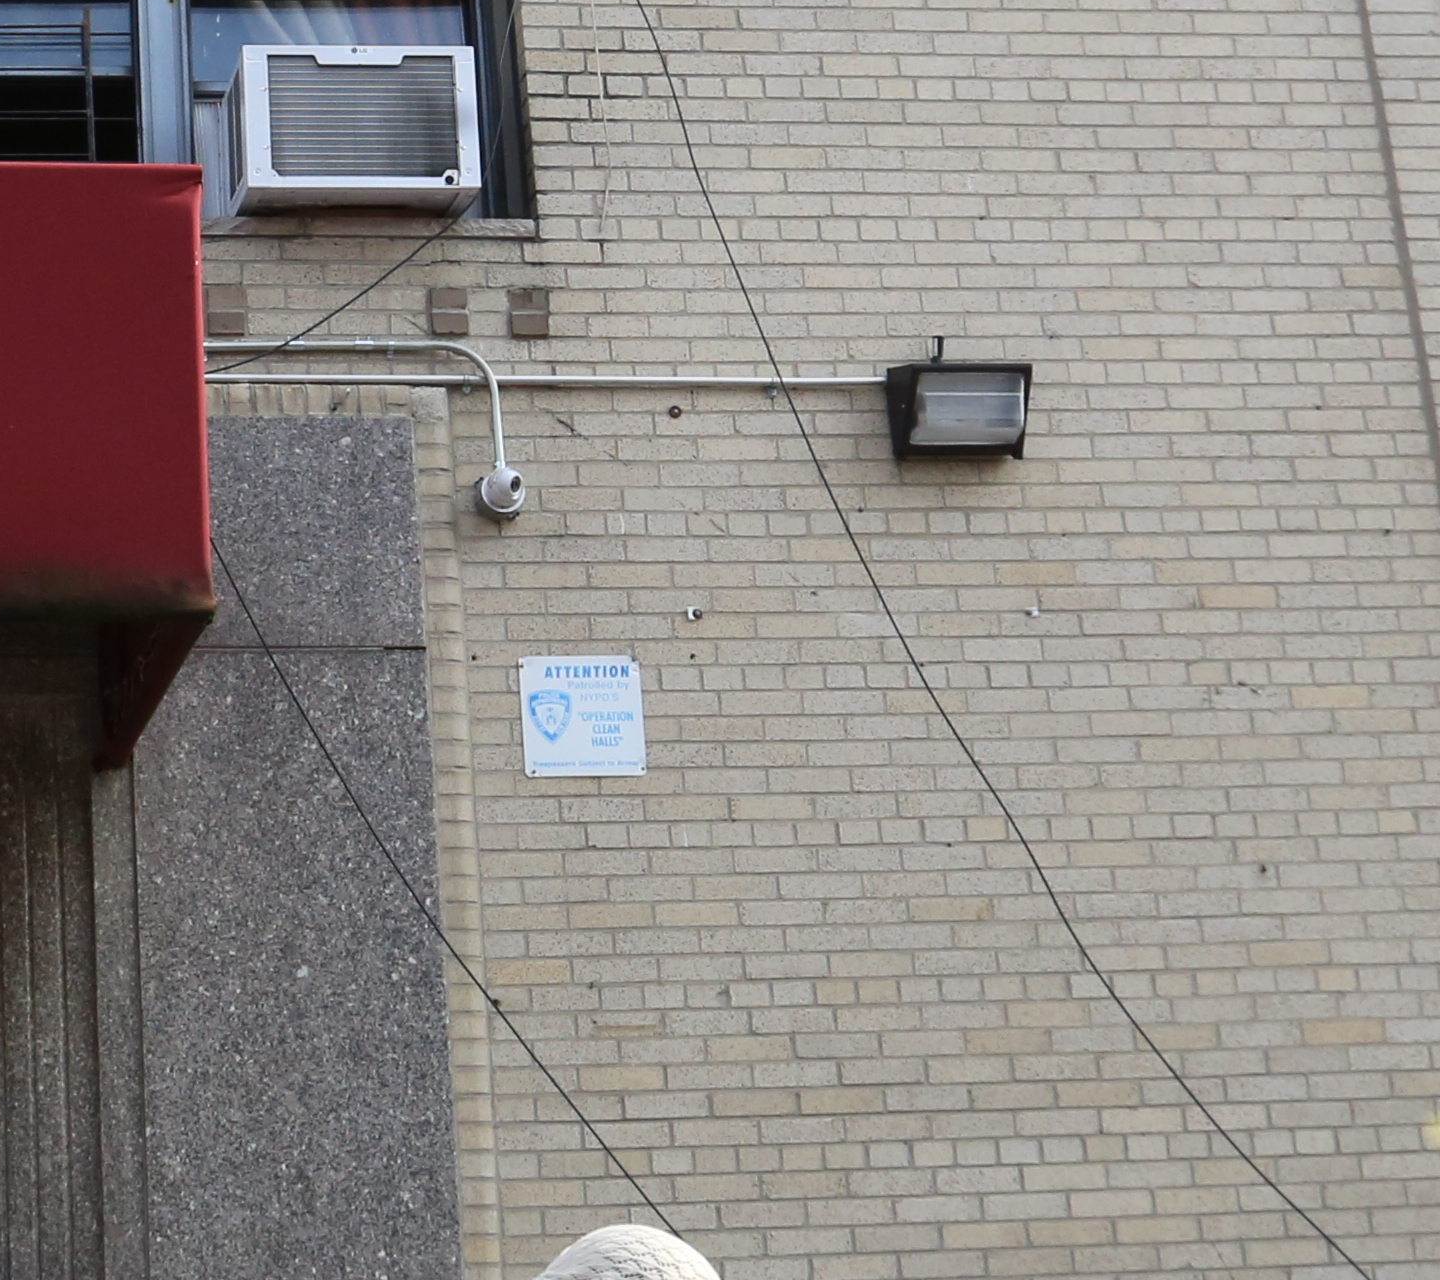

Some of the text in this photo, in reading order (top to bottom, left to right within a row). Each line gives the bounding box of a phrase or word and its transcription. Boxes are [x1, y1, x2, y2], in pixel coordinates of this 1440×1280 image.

[544, 665, 630, 678] ATTENTION
[567, 680, 630, 690] Patrolled by
[577, 711, 634, 722] "OPERATION
[592, 724, 621, 734] CLEAN
[591, 736, 624, 747] HALLS"
